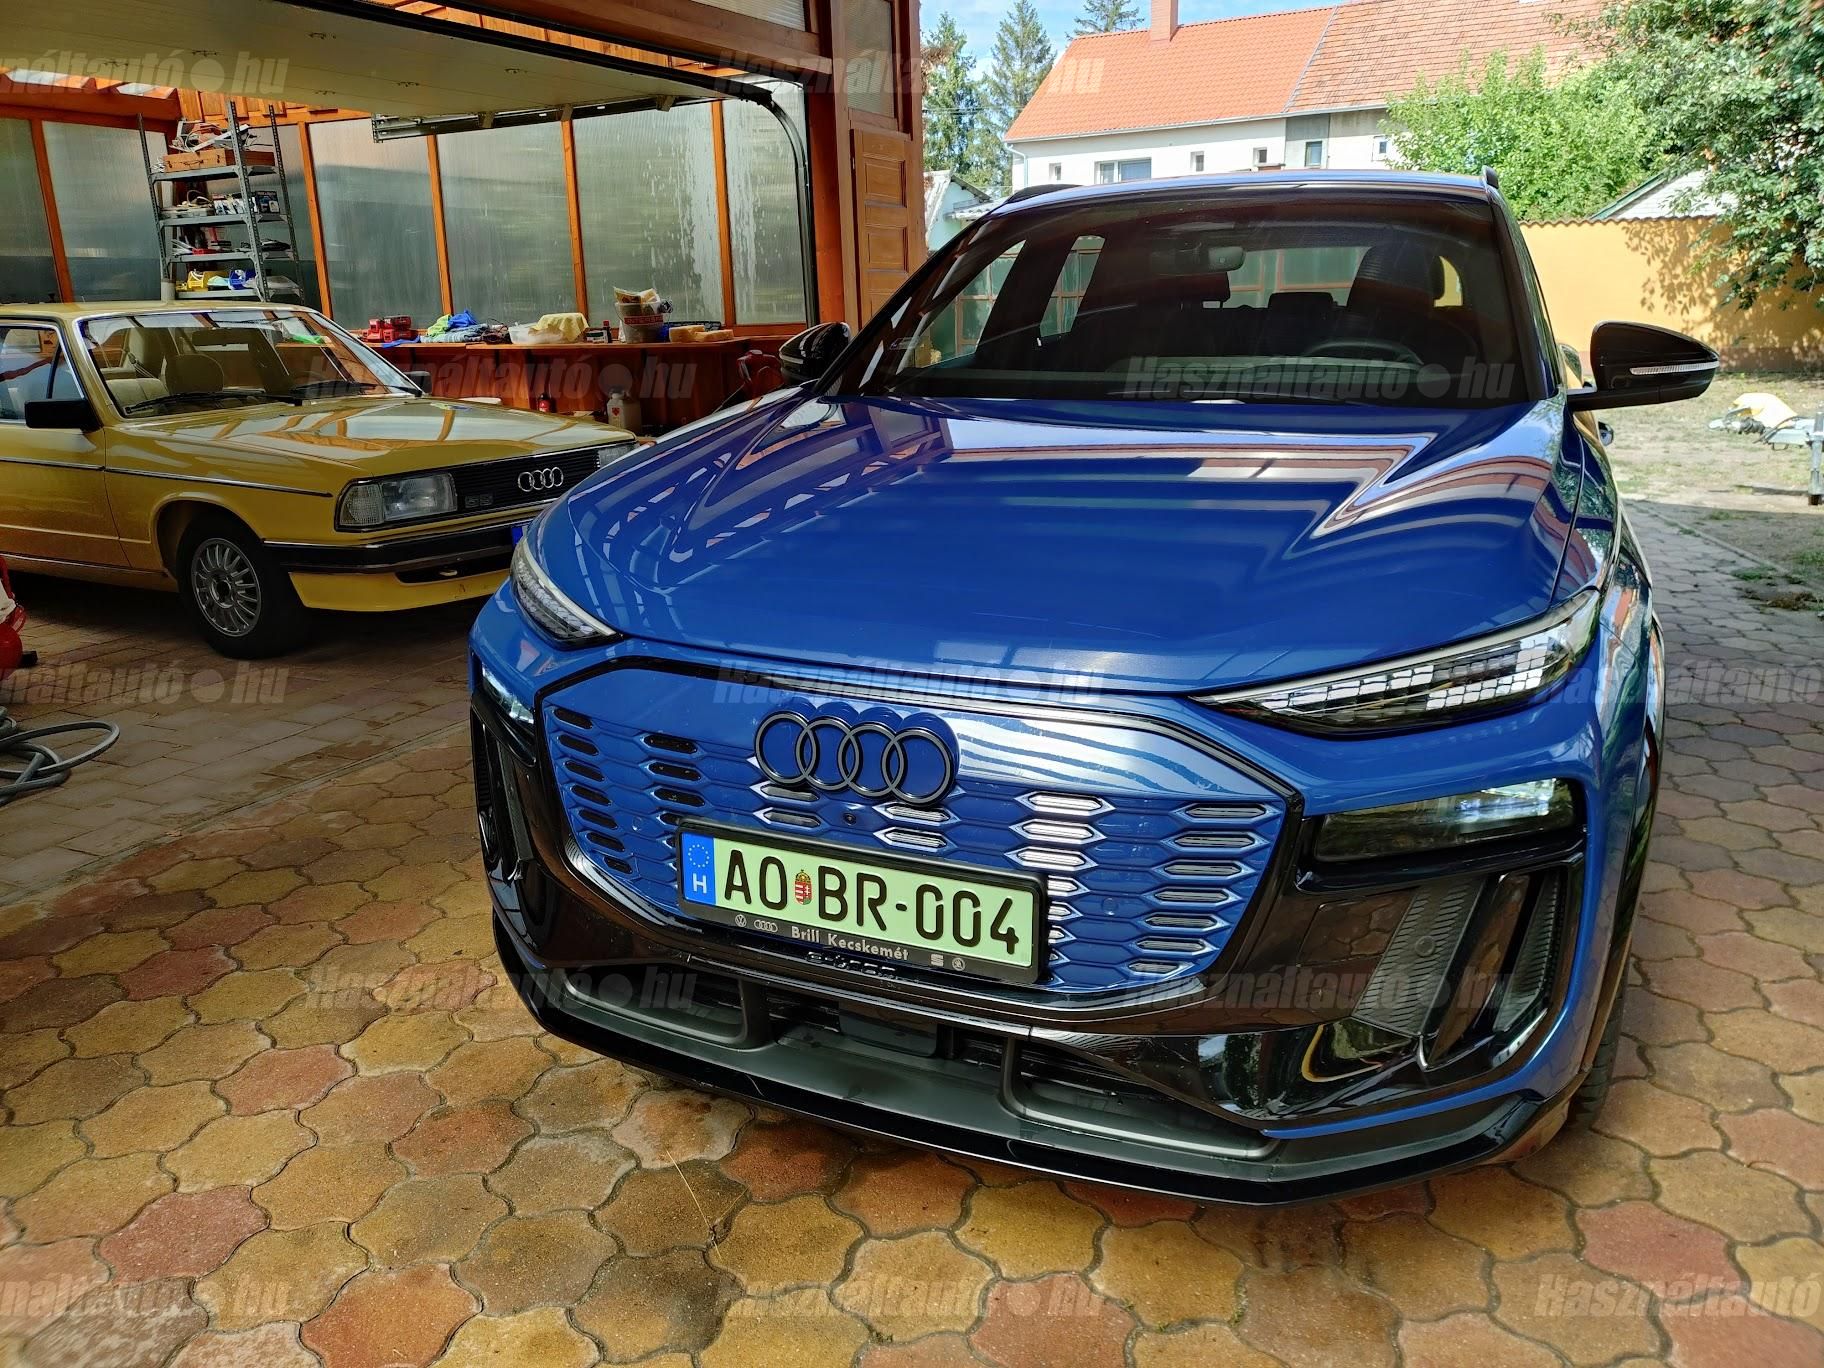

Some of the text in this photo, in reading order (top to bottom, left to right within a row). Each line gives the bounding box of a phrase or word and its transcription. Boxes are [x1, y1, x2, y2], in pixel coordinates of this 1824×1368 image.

[692, 872, 708, 894] H
[817, 865, 1020, 955] BR-004
[791, 926, 820, 943] Brill
[827, 933, 909, 961] Kecskemét
